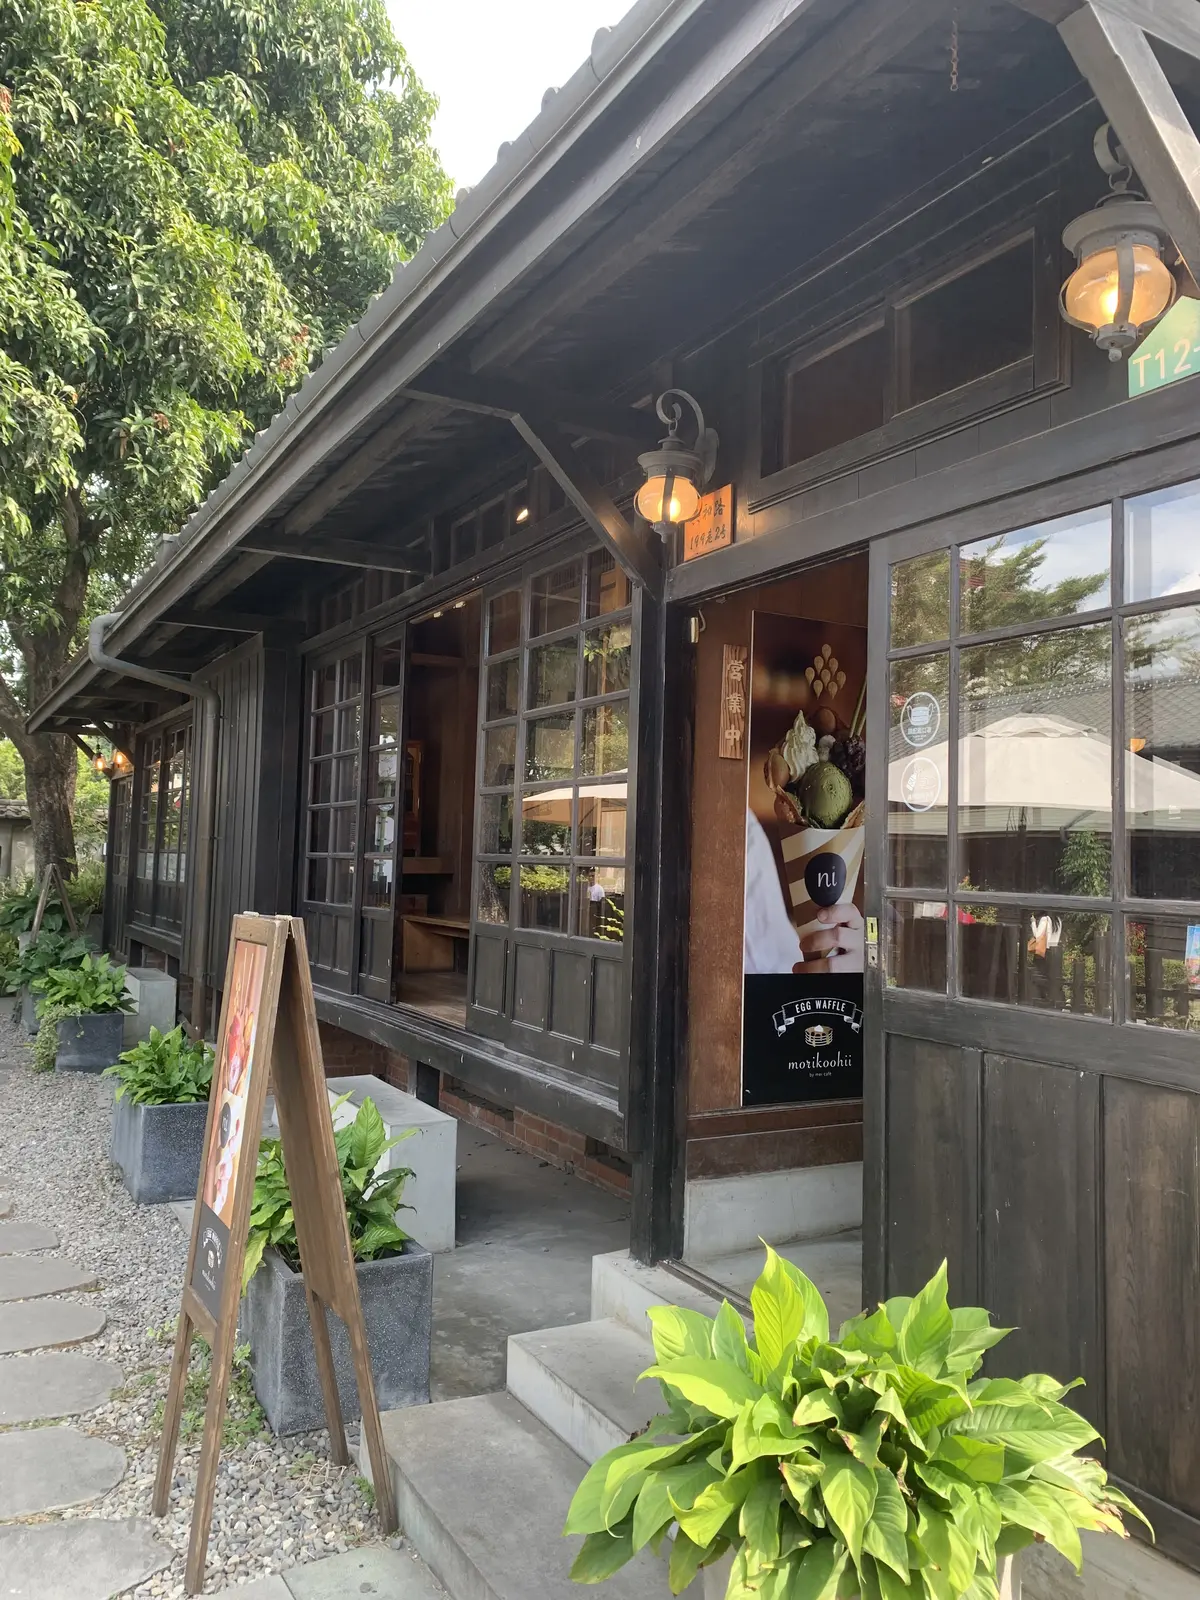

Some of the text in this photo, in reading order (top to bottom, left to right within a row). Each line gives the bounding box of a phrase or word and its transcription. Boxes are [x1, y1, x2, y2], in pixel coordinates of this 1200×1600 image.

[817, 865, 838, 888] ni
[795, 1000, 847, 1014] EGG WAFFLE
[788, 1051, 852, 1070] morikoohii
